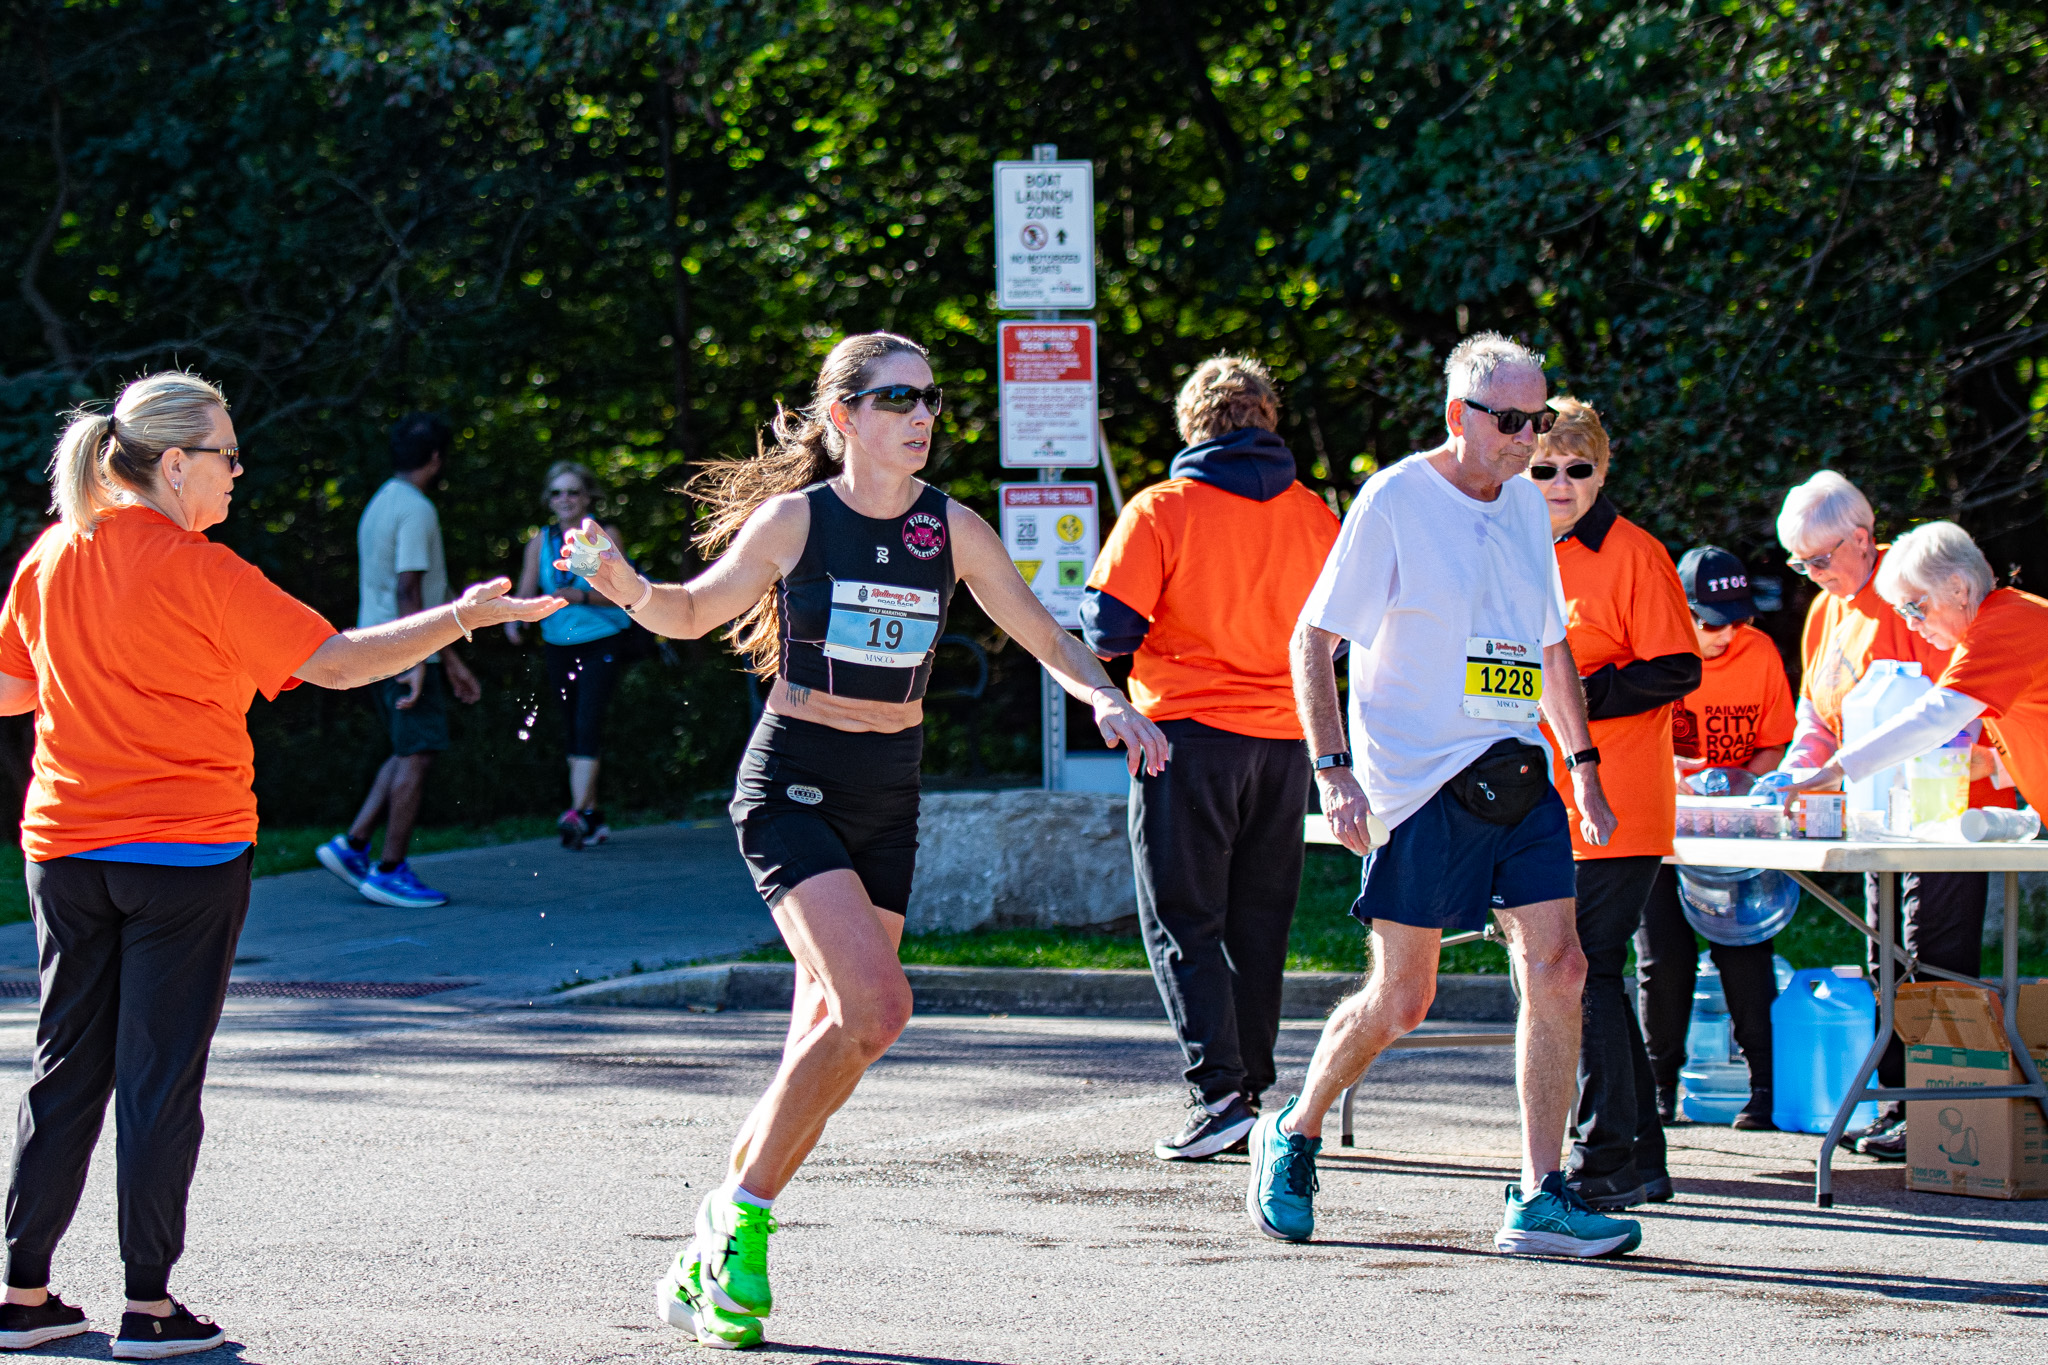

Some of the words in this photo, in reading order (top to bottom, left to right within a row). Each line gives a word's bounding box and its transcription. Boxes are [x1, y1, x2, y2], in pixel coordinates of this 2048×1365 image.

[1024, 174, 1062, 188] BOAT
[1015, 190, 1074, 204] LAUNCH
[1026, 207, 1064, 220] ZONE
[1011, 254, 1026, 264] NO
[1027, 254, 1081, 265] MOTORIZED
[1030, 265, 1062, 275] BOATS
[1008, 491, 1041, 504] SHARE
[1043, 491, 1061, 503] THE
[1062, 491, 1090, 504] TRAIL
[909, 514, 941, 530] FIERCE
[1018, 522, 1036, 537] 20
[906, 543, 940, 558] ATHLETICS
[1708, 575, 1748, 592] TTOC
[871, 588, 905, 603] Railway
[904, 592, 921, 604] City
[881, 608, 907, 617] MARATHON
[866, 617, 904, 650] 19
[864, 653, 892, 664] MASCO
[1480, 666, 1534, 697] 1228
[1705, 703, 1761, 715] RAILWAY
[1706, 713, 1760, 734] CITY
[1706, 731, 1757, 749] ROAD
[1706, 744, 1755, 764] RACE
